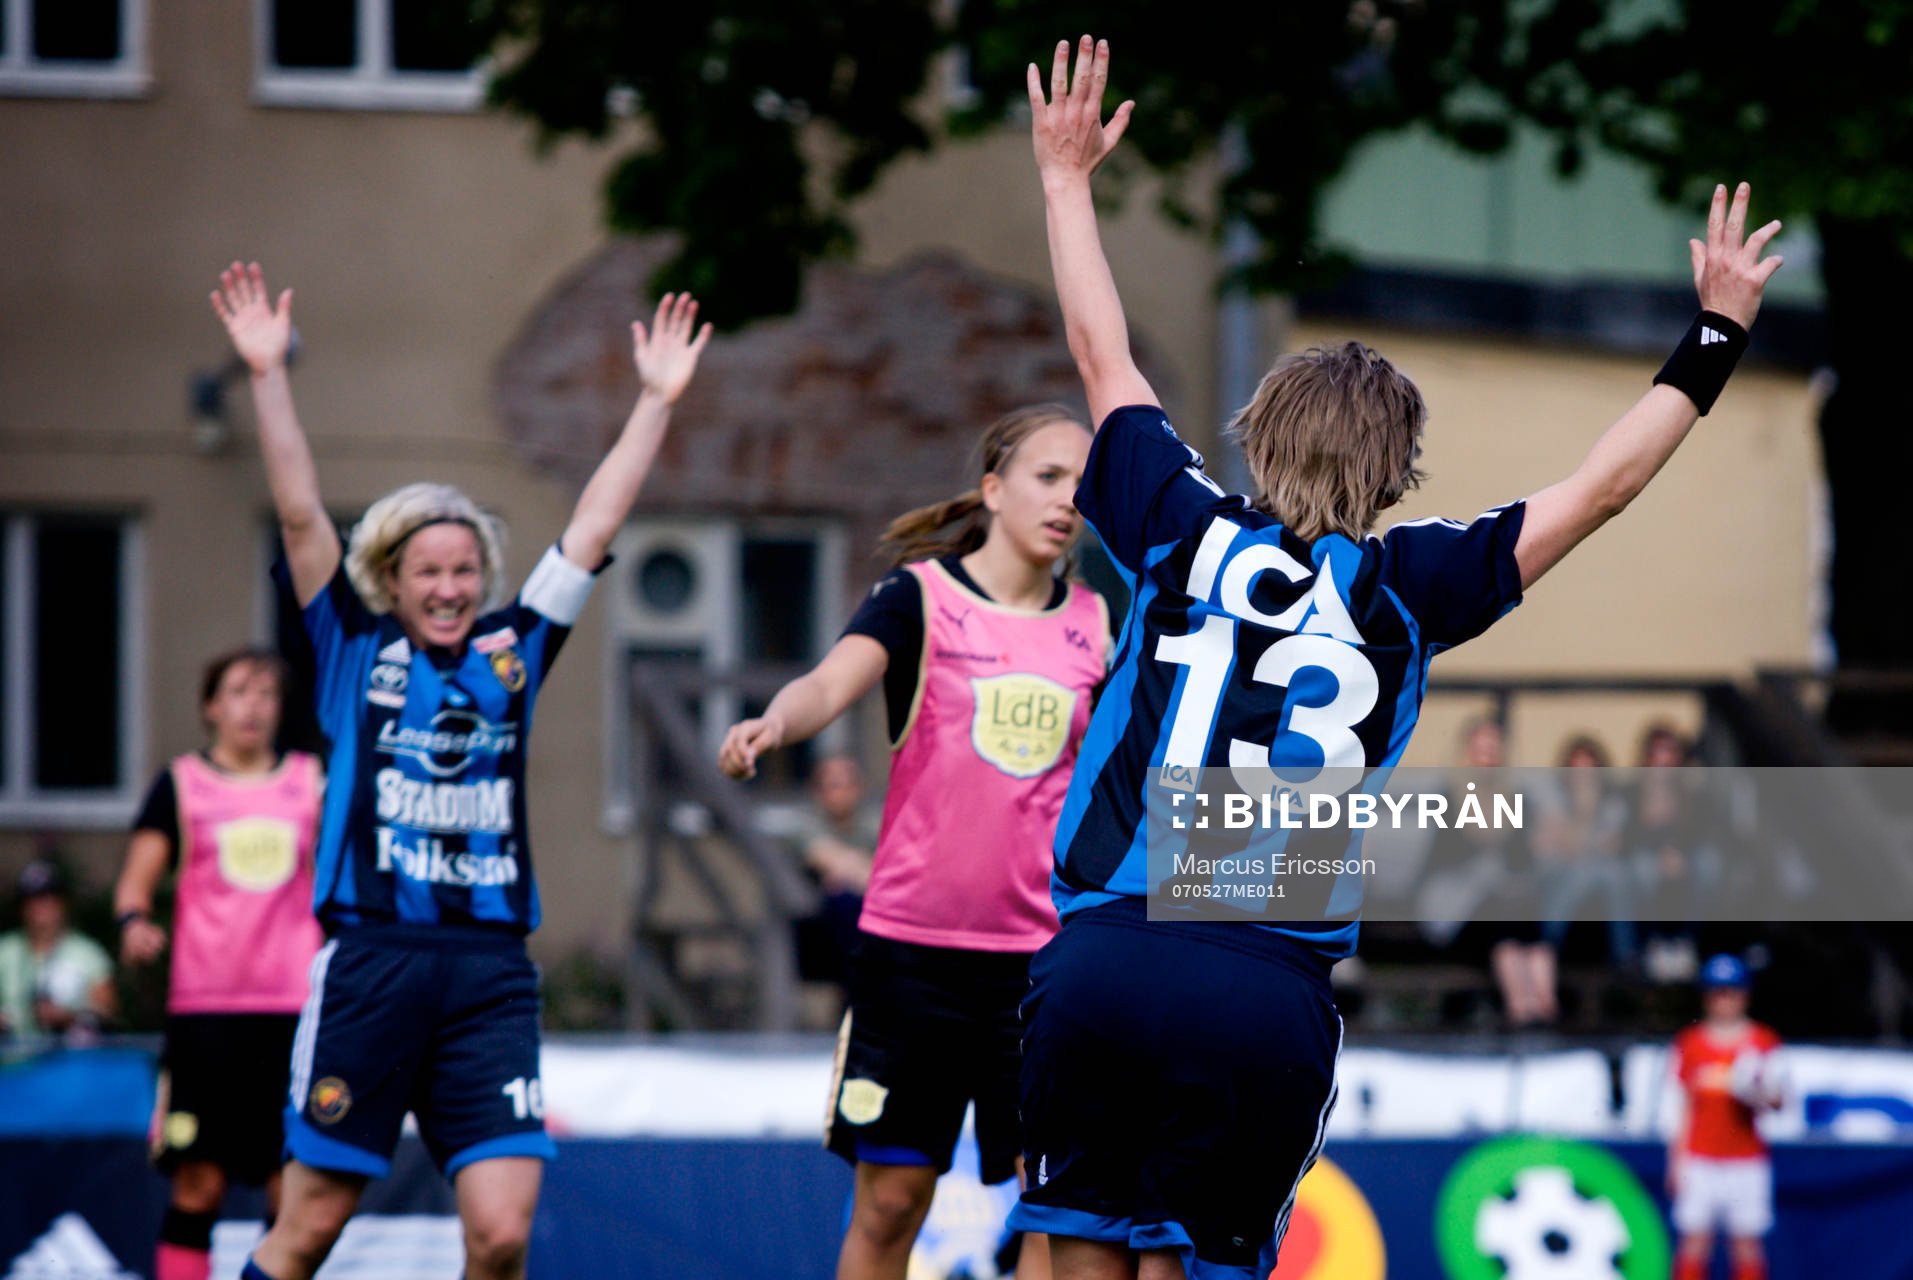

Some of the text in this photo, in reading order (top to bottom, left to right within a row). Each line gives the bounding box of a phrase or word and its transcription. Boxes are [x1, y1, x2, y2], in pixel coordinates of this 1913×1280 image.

[1186, 516, 1366, 645] ICA
[991, 688, 1060, 730] LdB
[1154, 614, 1379, 814] 13
[1162, 763, 1192, 785] ICA
[1271, 785, 1303, 808] ICA
